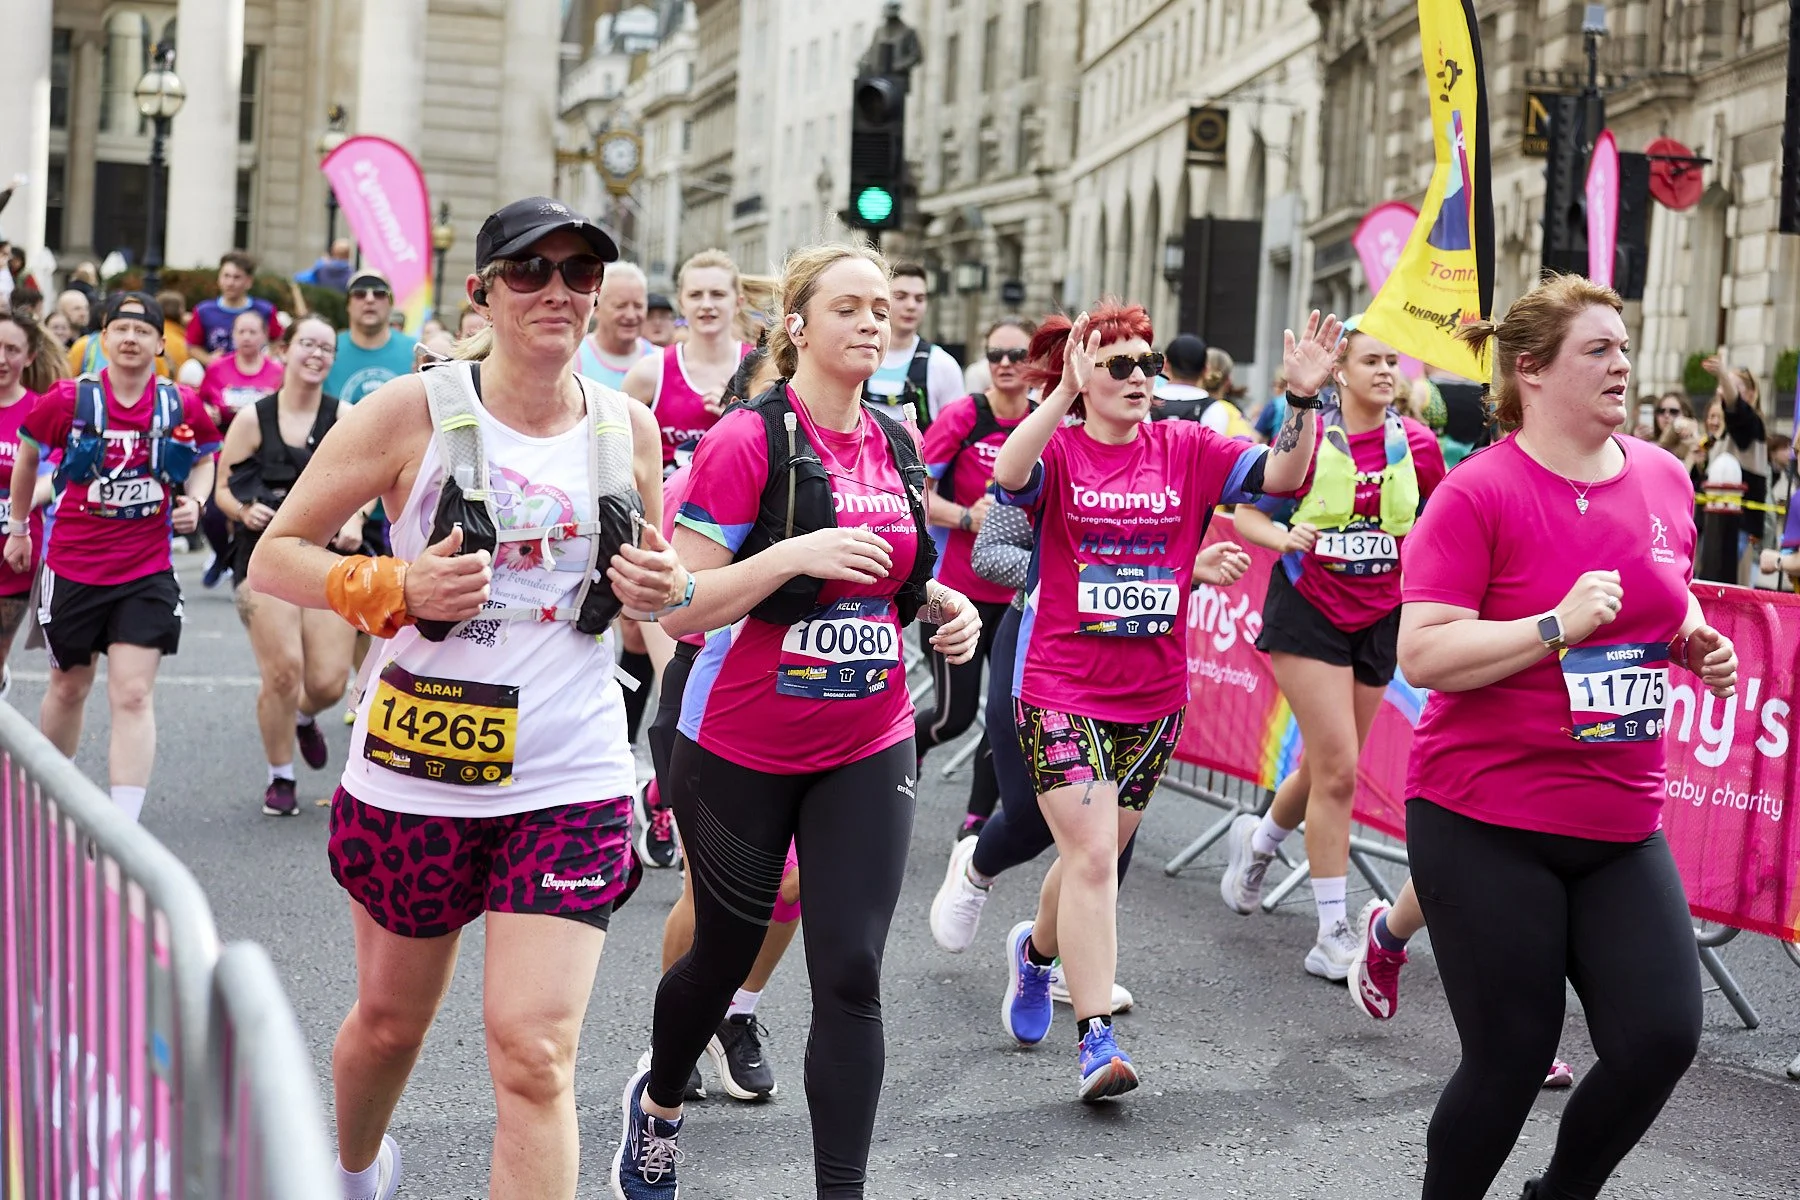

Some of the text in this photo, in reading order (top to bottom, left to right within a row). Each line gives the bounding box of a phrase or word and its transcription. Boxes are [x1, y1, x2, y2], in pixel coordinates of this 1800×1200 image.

[1403, 301, 1447, 325] LONDON
[1071, 482, 1181, 514] Tommy's
[892, 524, 909, 534] baby
[1067, 512, 1181, 526] The pregnancy and baby charity
[1079, 532, 1168, 555] ASHER
[1326, 536, 1392, 555] 11370
[1116, 567, 1144, 577] ASHER
[837, 602, 861, 611] KELLY
[1087, 586, 1171, 611] 10667
[798, 622, 892, 655] 10080
[1606, 649, 1645, 661] KIRSTY
[414, 682, 463, 698] SARAH
[1578, 672, 1664, 706] 11775
[382, 696, 505, 754] 14265
[1712, 783, 1783, 821] charity
